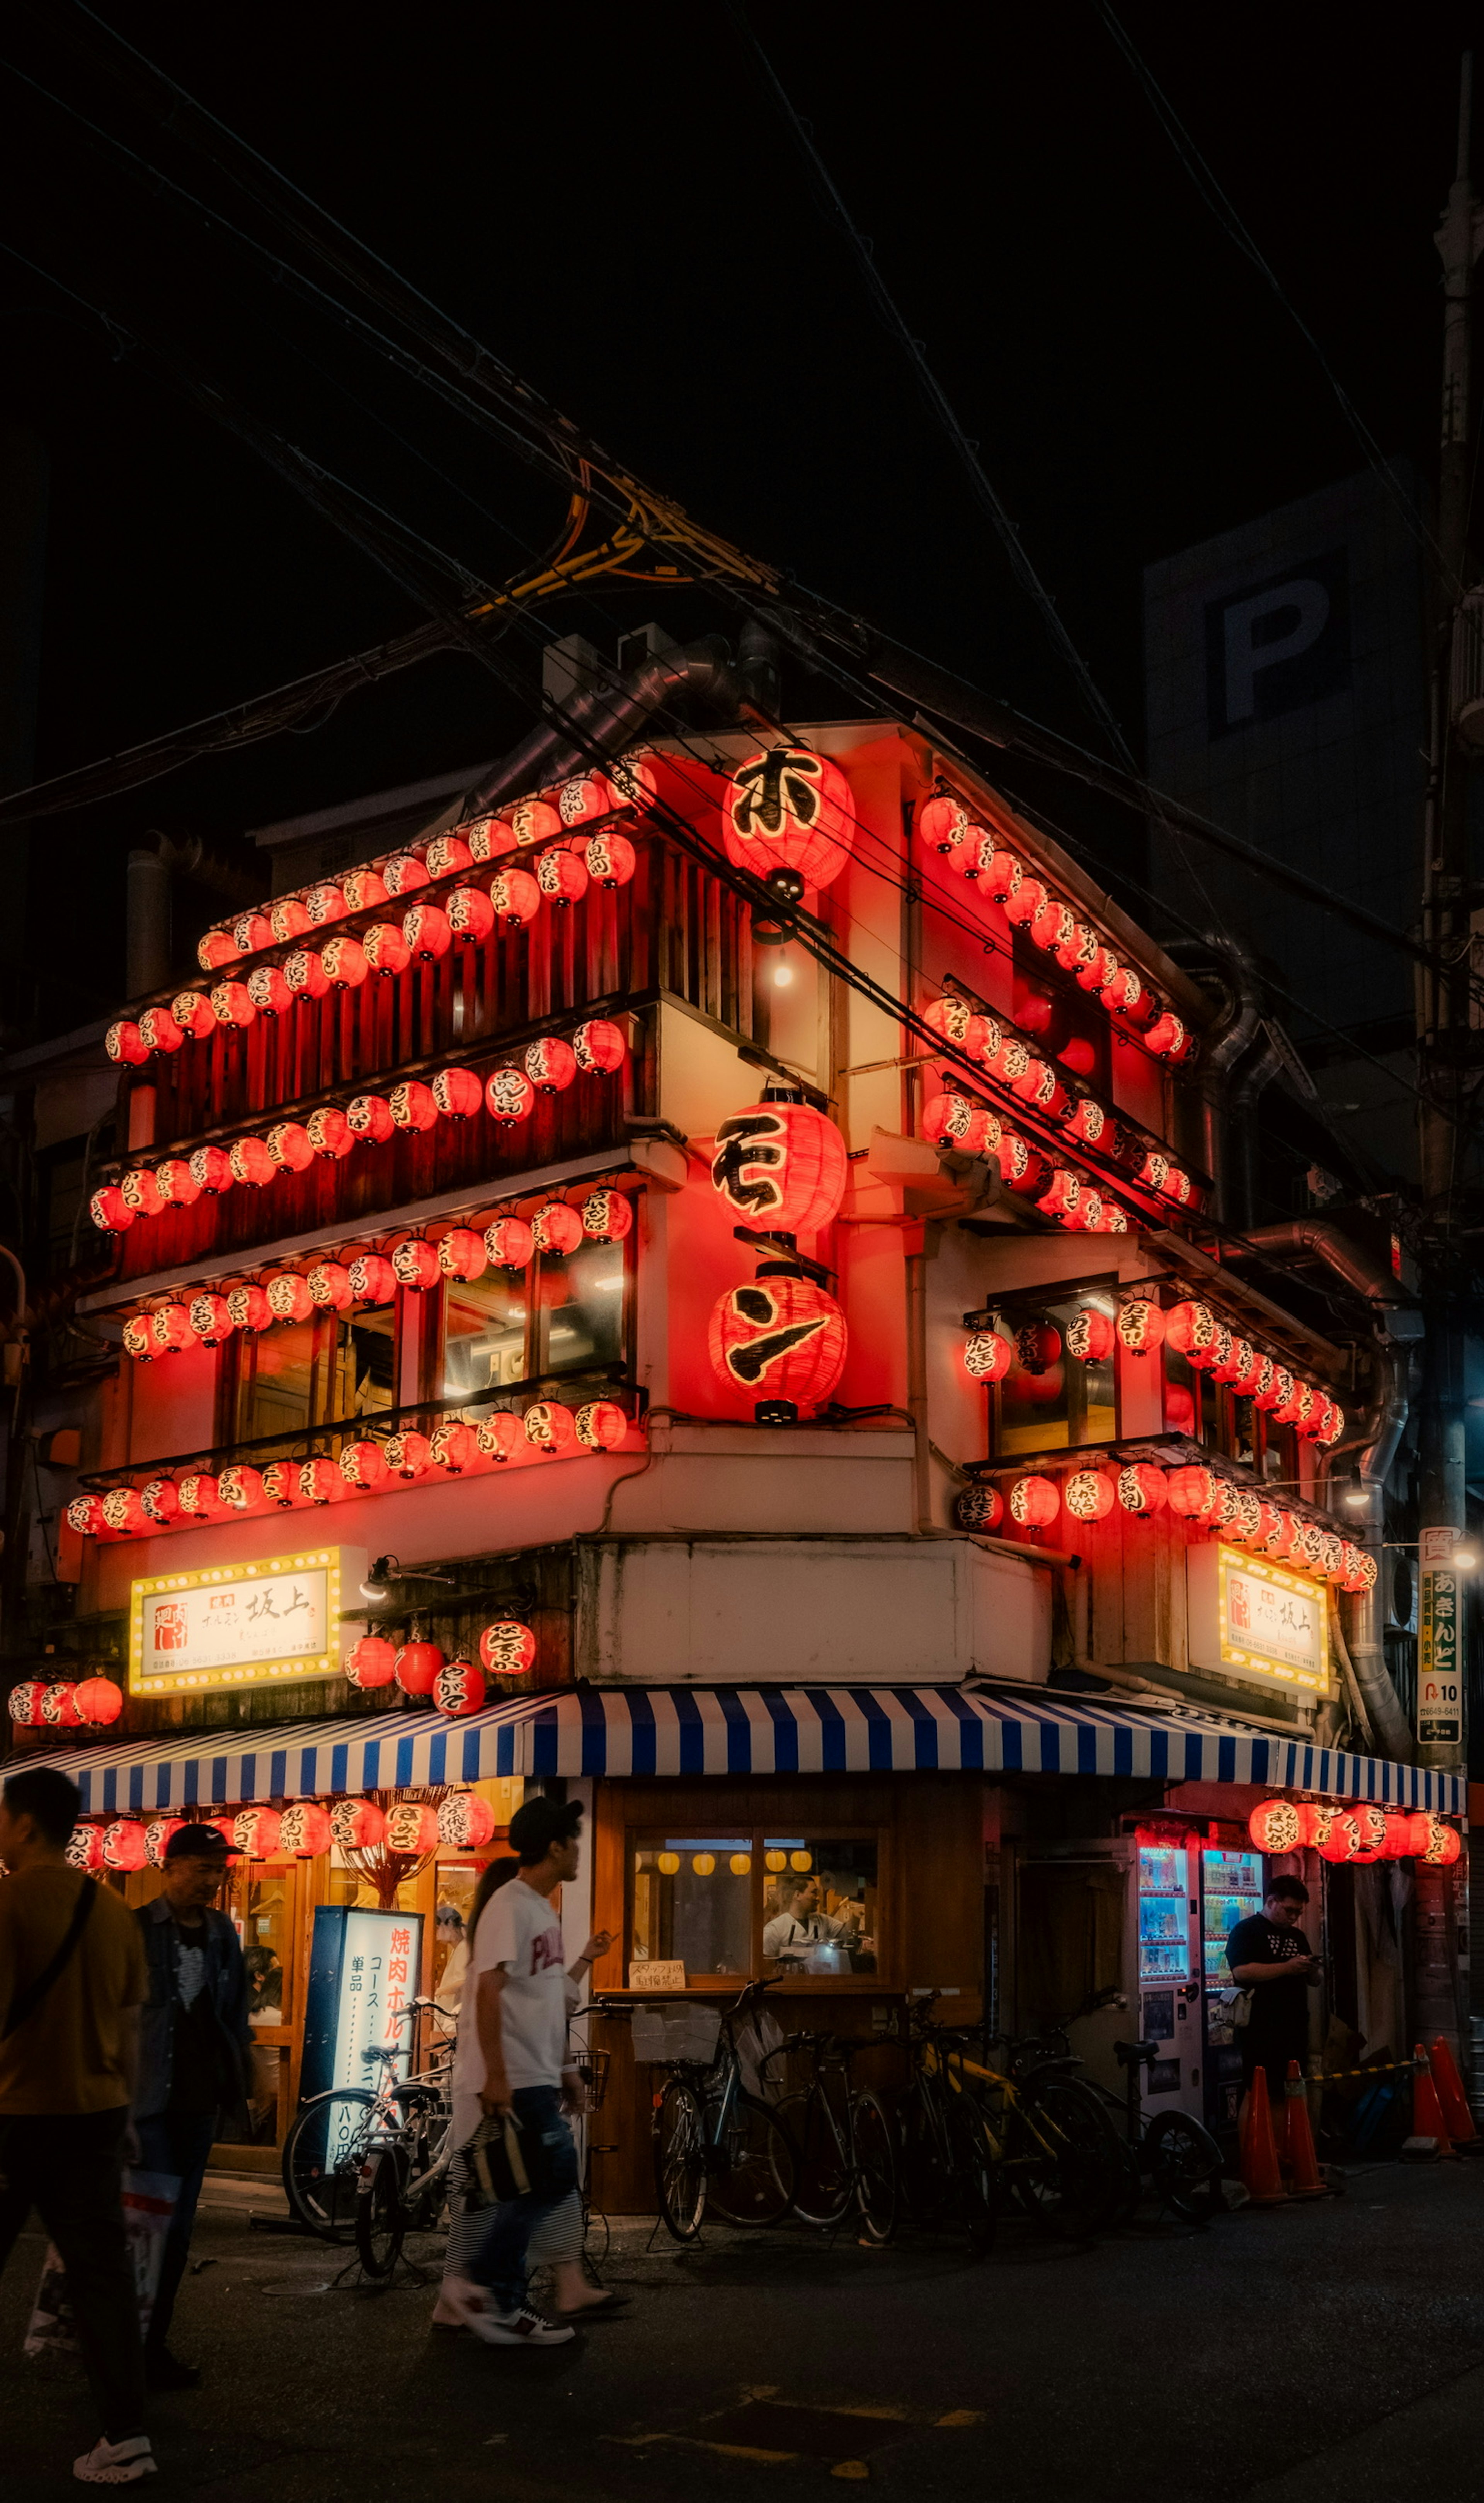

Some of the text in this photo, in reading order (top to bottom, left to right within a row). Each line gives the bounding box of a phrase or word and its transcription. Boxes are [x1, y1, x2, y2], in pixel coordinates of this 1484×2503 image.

[1224, 579, 1330, 724] P
[713, 749, 830, 1384] ホ モ ン
[394, 1245, 419, 1280] まいど
[967, 1335, 994, 1370] ホルモン
[1068, 1314, 1087, 1355] あほか
[526, 1406, 549, 1444] へたれ
[245, 1586, 309, 1621] 坂上
[1280, 1602, 1310, 1630] 坂上
[1434, 1573, 1455, 1668] あきんど
[1426, 1707, 1459, 1716] 6649-6411
[1441, 1685, 1457, 1701] 10
[331, 1803, 360, 1845] 焼きまっせ
[389, 1807, 421, 1848] はみご
[350, 1956, 364, 1992] 単品
[368, 1956, 382, 2008] コース
[633, 1965, 684, 1975] スタッフ以外
